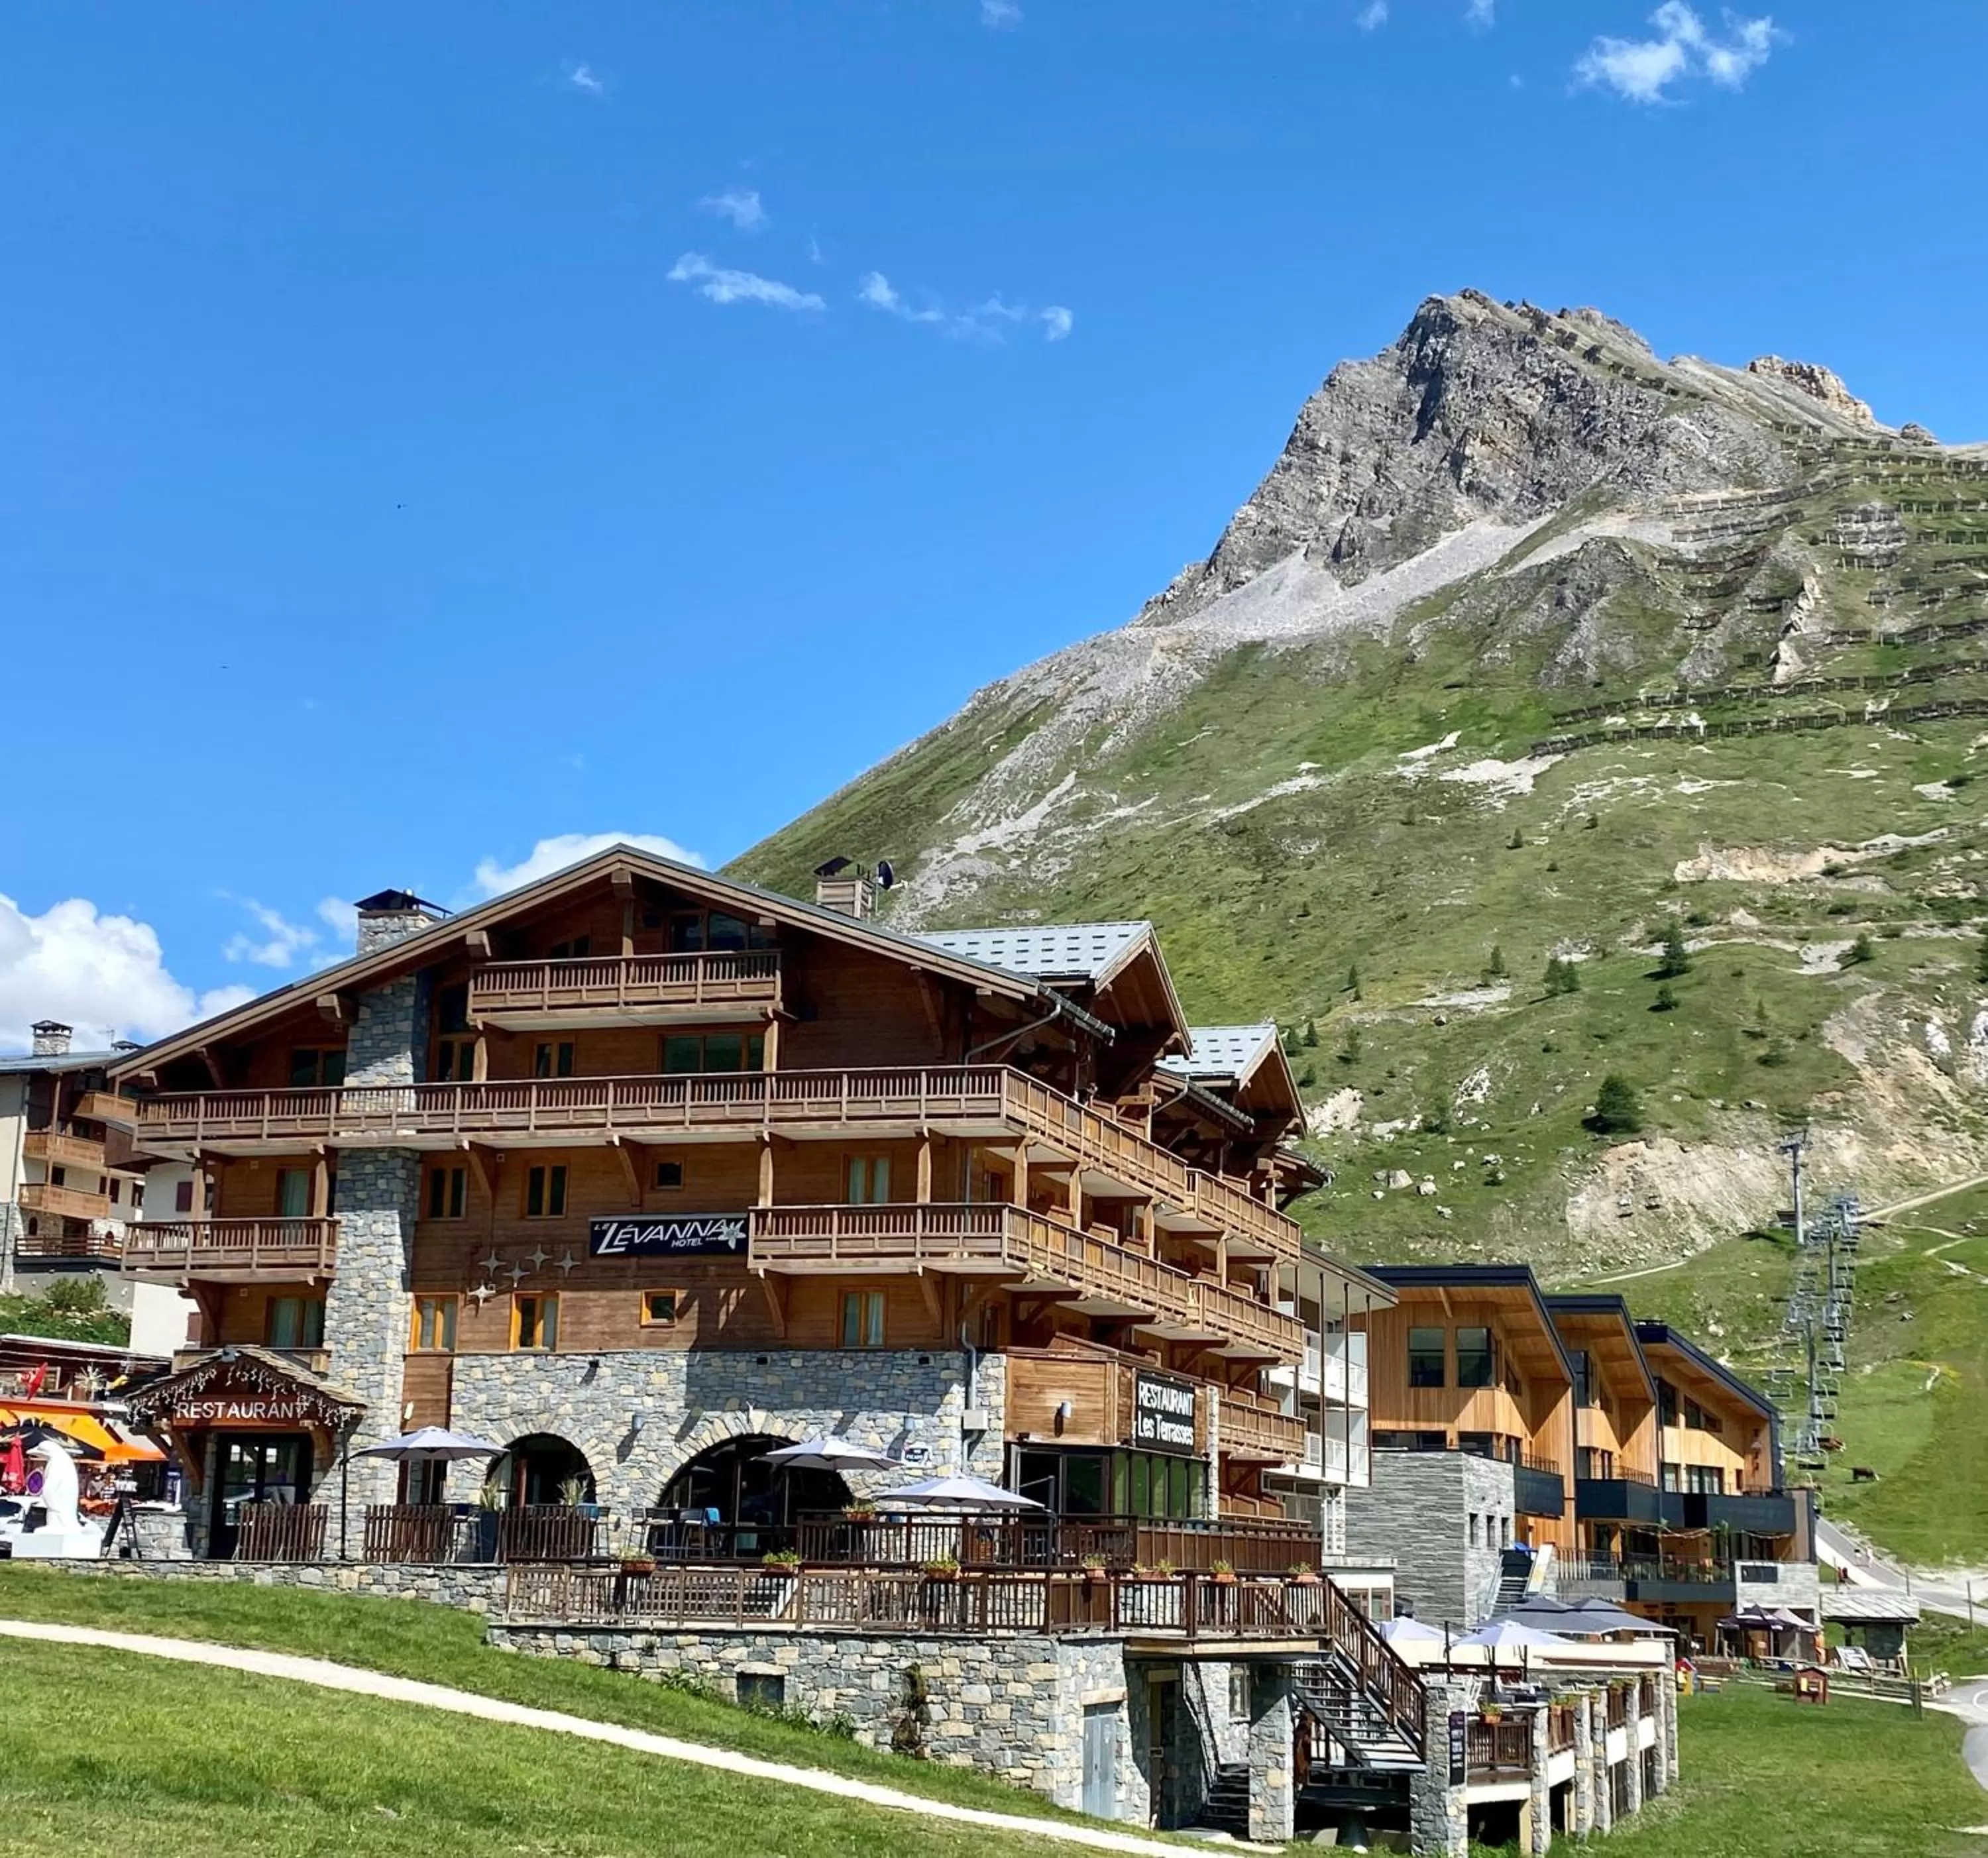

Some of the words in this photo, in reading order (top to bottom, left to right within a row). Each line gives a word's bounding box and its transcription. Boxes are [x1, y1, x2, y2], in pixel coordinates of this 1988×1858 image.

[671, 1236, 704, 1248] HOTEL
[176, 1401, 304, 1419] RESTAURANT
[1138, 1381, 1194, 1416] RESTAURANT
[1138, 1410, 1154, 1439] Les
[1155, 1413, 1193, 1446] Terrasses
